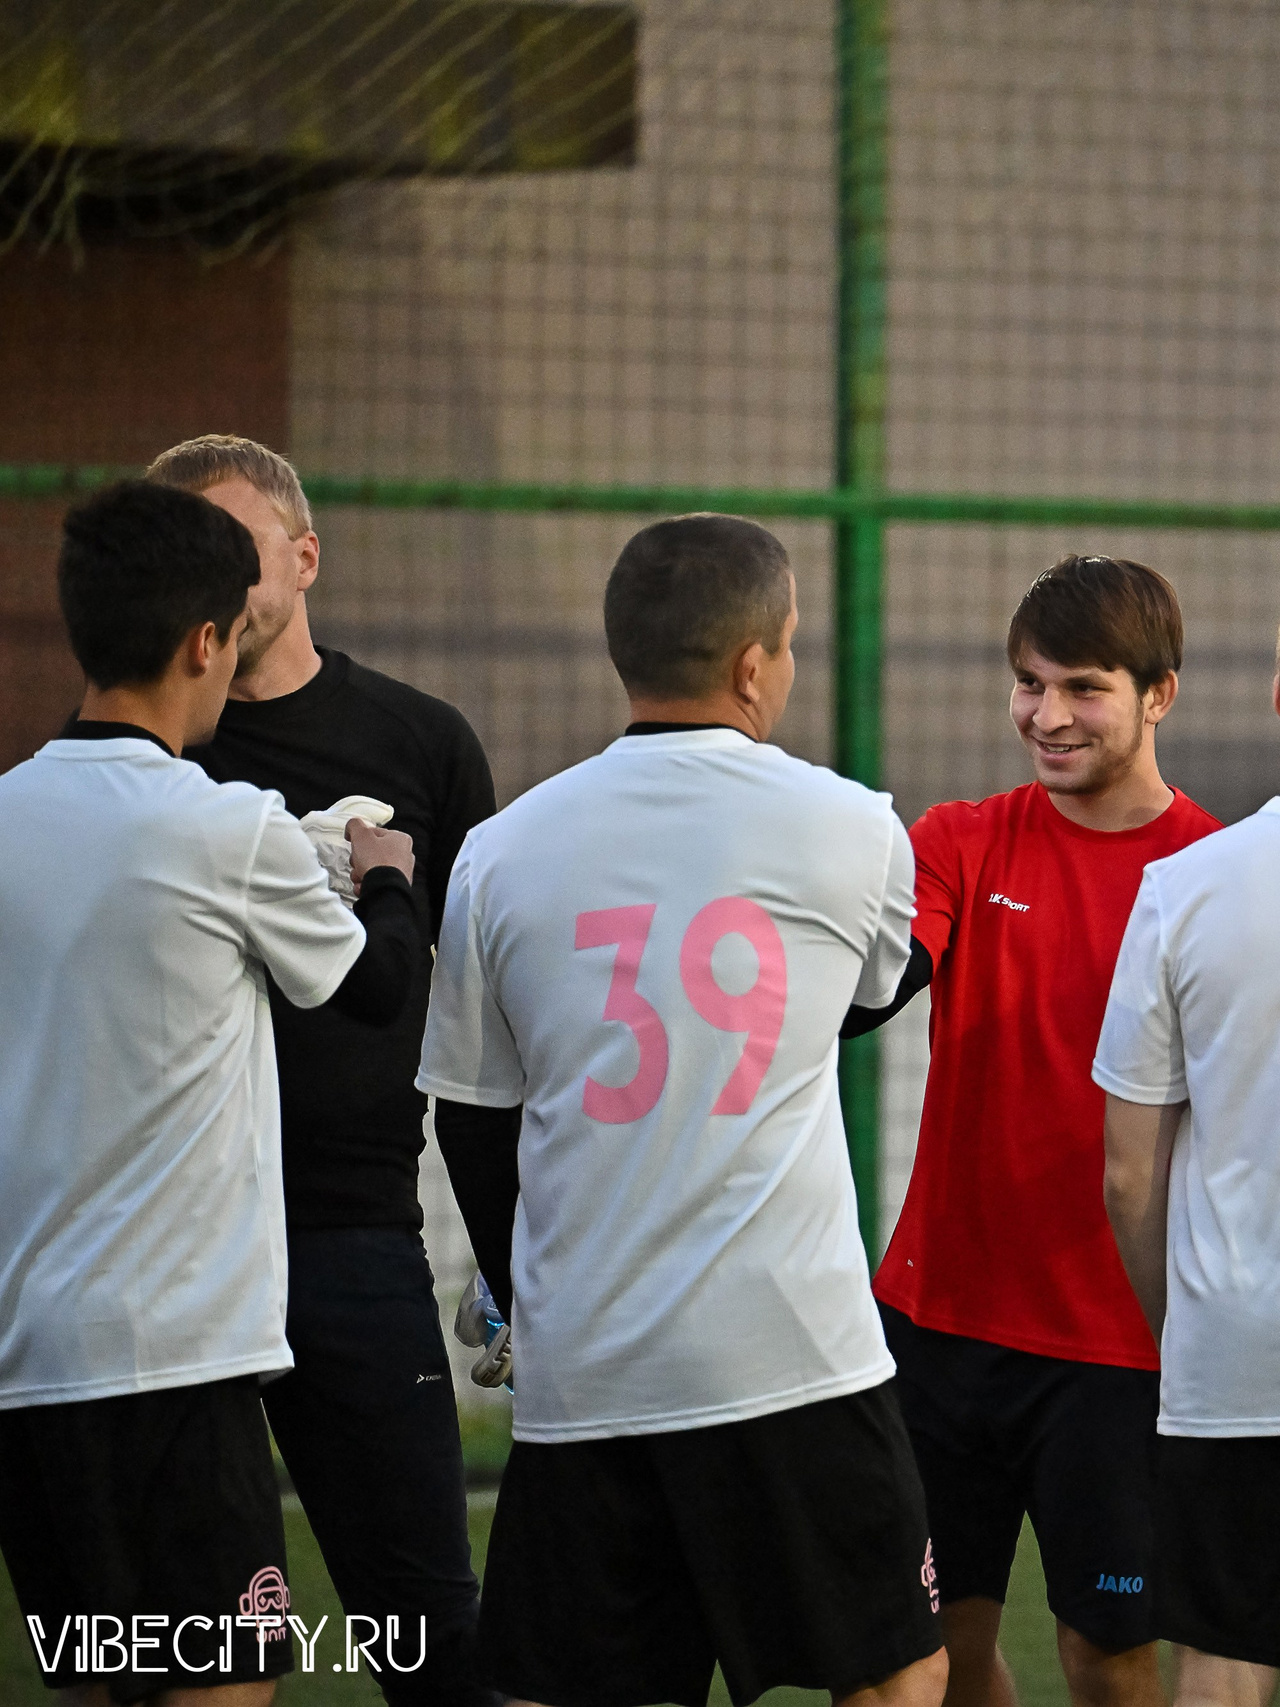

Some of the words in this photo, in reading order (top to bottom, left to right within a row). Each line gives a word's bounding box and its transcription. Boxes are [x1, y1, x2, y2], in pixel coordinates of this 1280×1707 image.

[1001, 897, 1030, 912] SORT
[574, 896, 788, 1125] 39
[1096, 1573, 1144, 1594] JAKO
